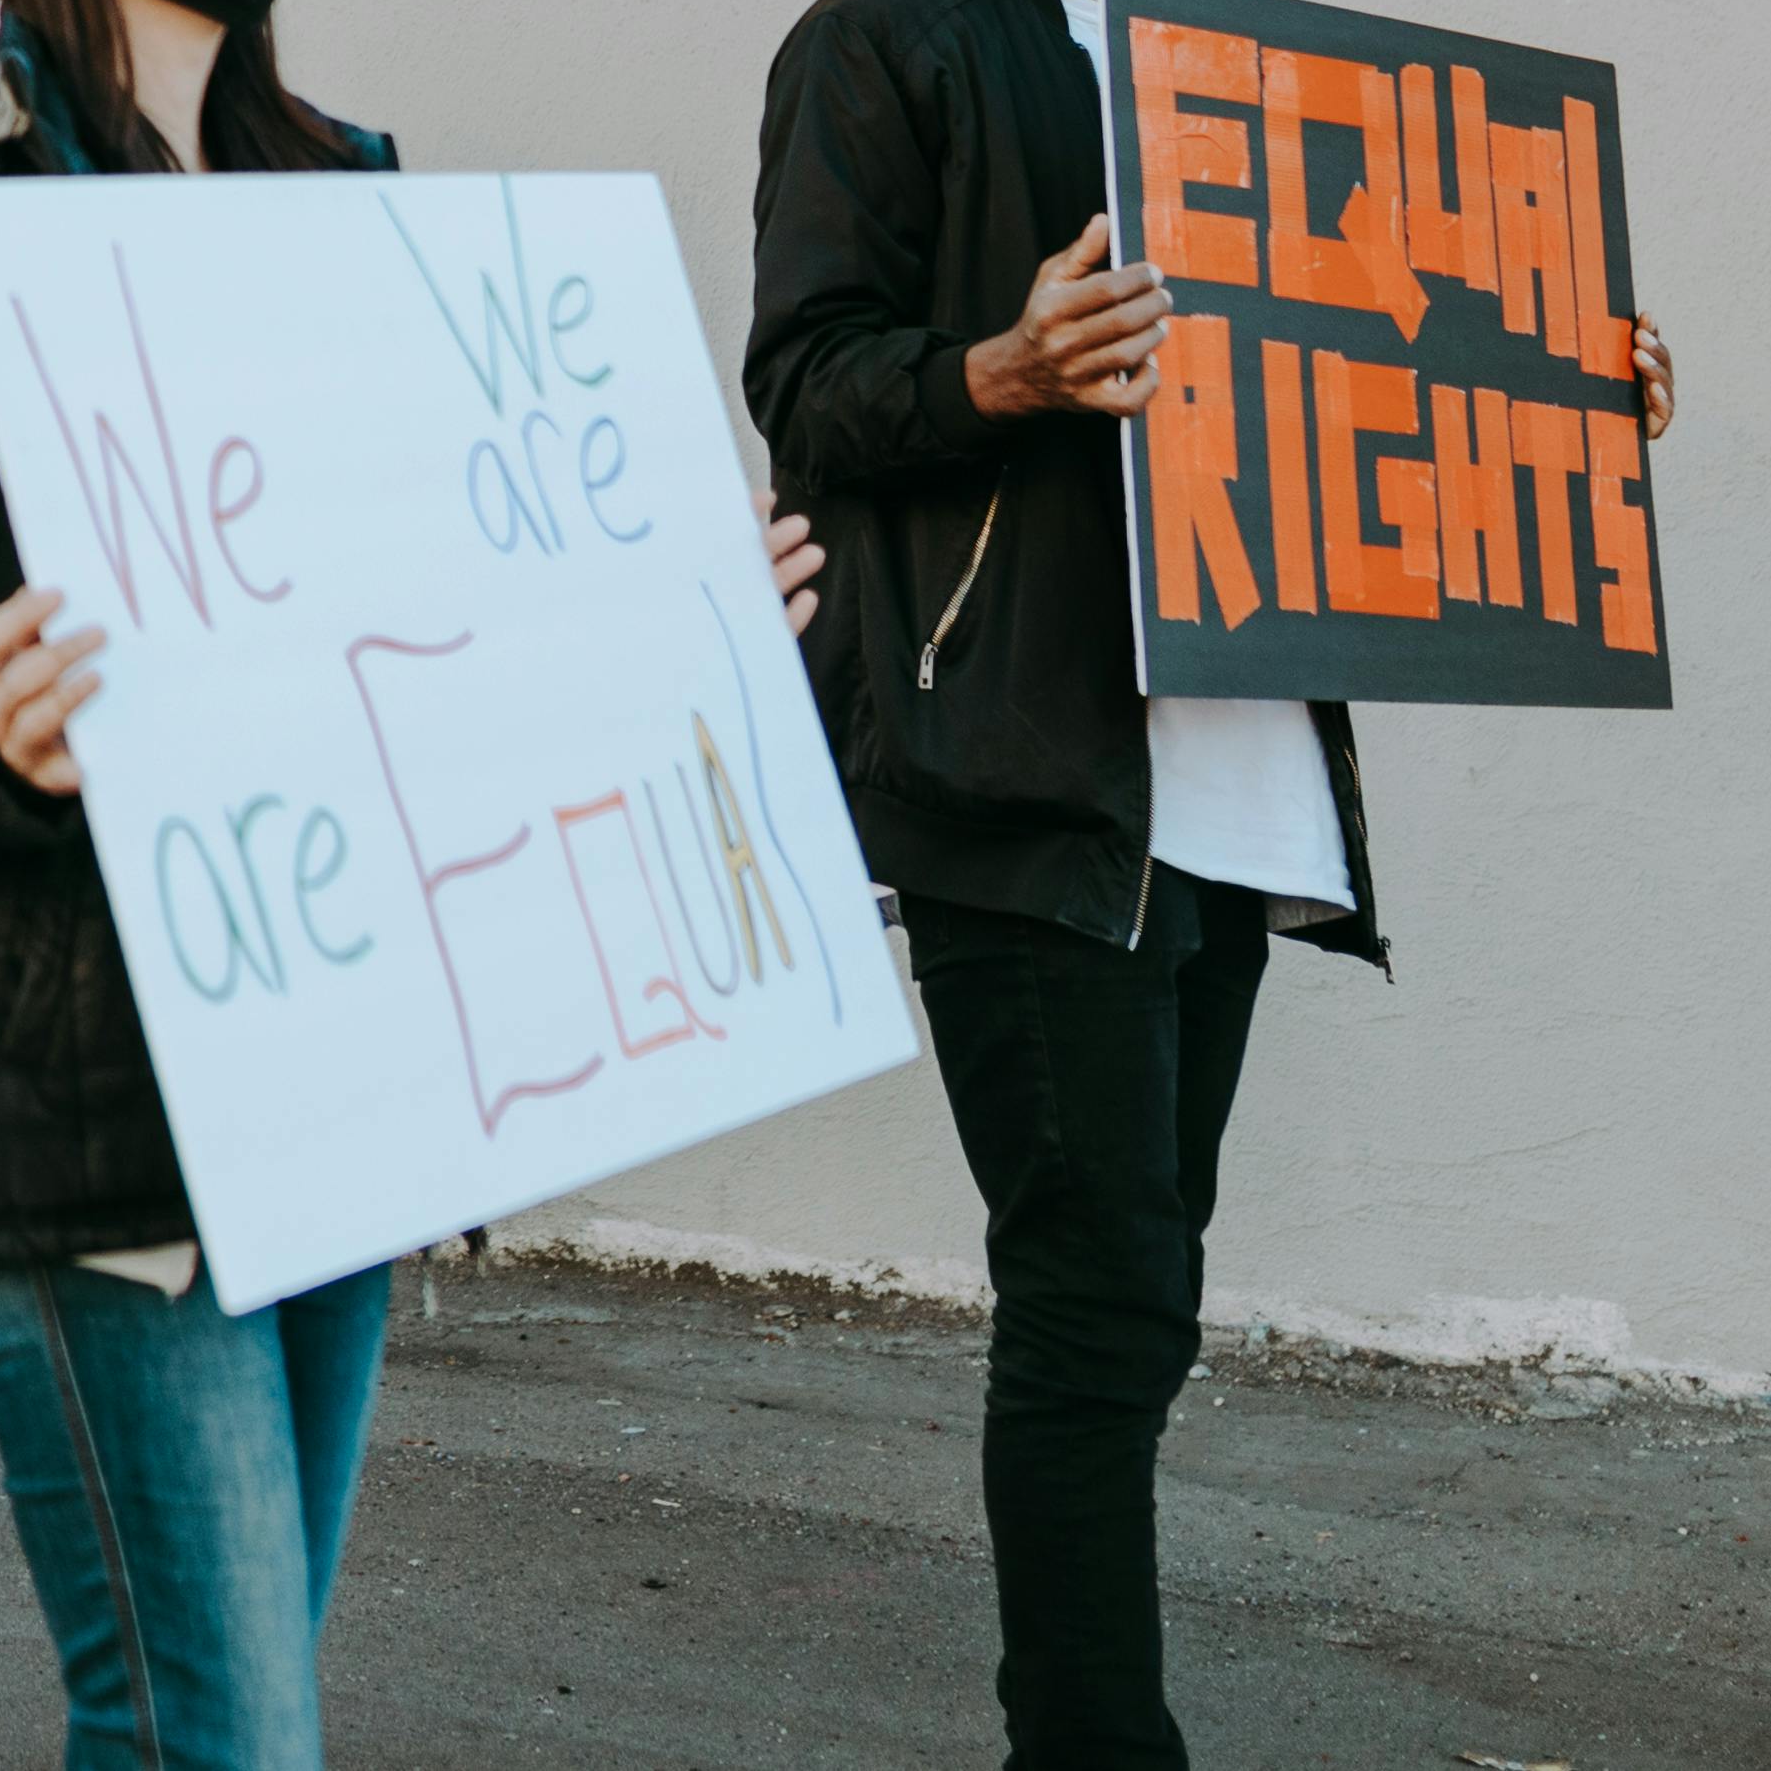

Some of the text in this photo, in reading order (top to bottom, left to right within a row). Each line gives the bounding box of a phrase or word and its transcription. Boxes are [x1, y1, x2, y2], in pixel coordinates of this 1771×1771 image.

[376, 172, 613, 418] We
[1128, 16, 1635, 382] EQUAL
[10, 239, 293, 631] We
[465, 409, 653, 558] are
[1145, 312, 1658, 657] RIGHTS
[154, 792, 374, 1003] are
